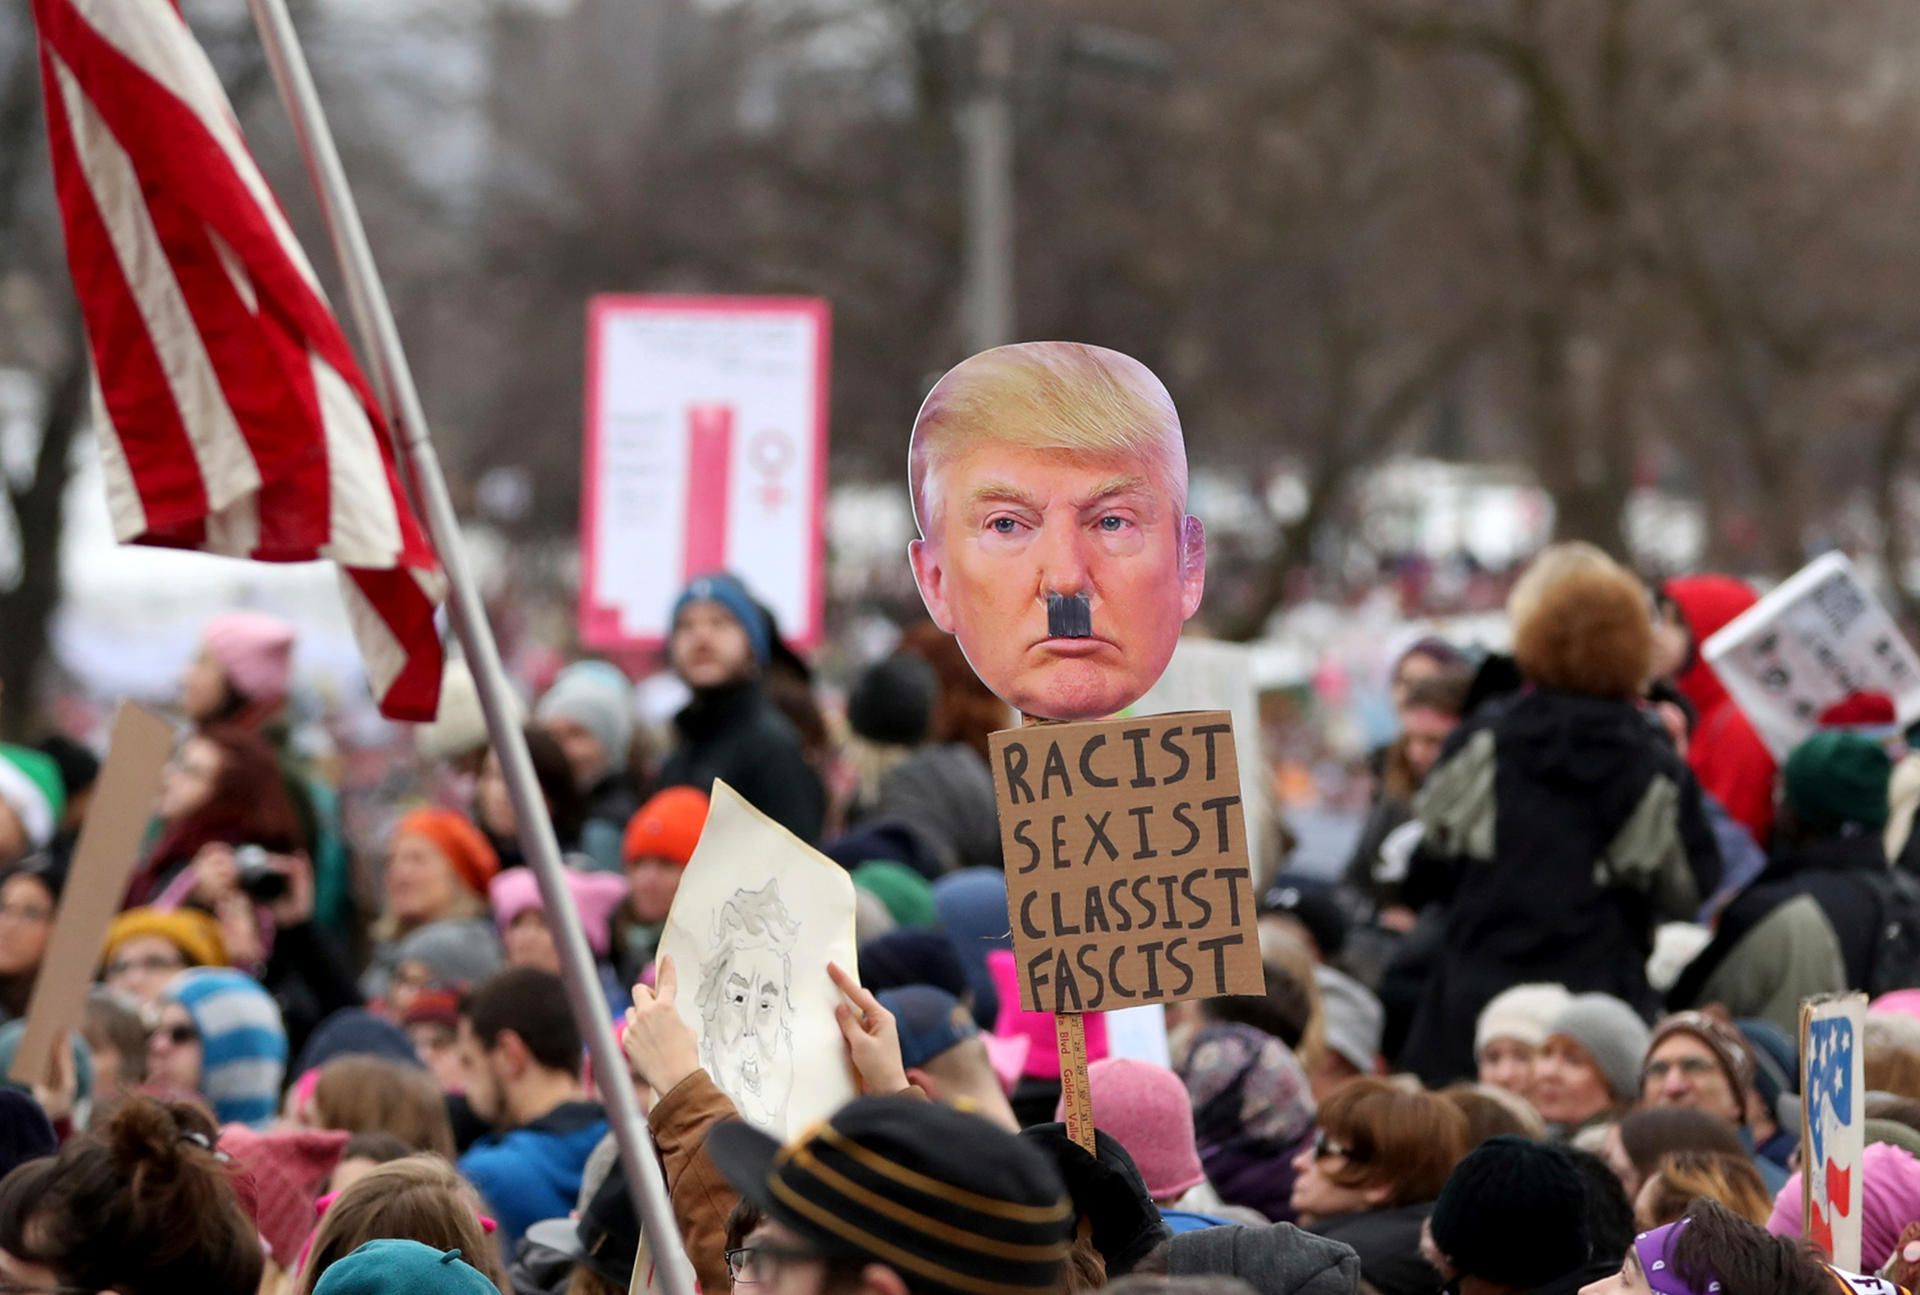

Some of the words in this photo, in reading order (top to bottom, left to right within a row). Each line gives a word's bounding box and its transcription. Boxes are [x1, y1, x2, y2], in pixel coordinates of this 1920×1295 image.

[1003, 724, 1231, 804] RACIST
[1013, 795, 1240, 874] SEXIST
[1020, 868, 1249, 939] CLASSIST
[1027, 933, 1244, 1013] FASCIST
[1059, 1031, 1071, 1055] Blvd
[1063, 1068, 1075, 1107] Golden
